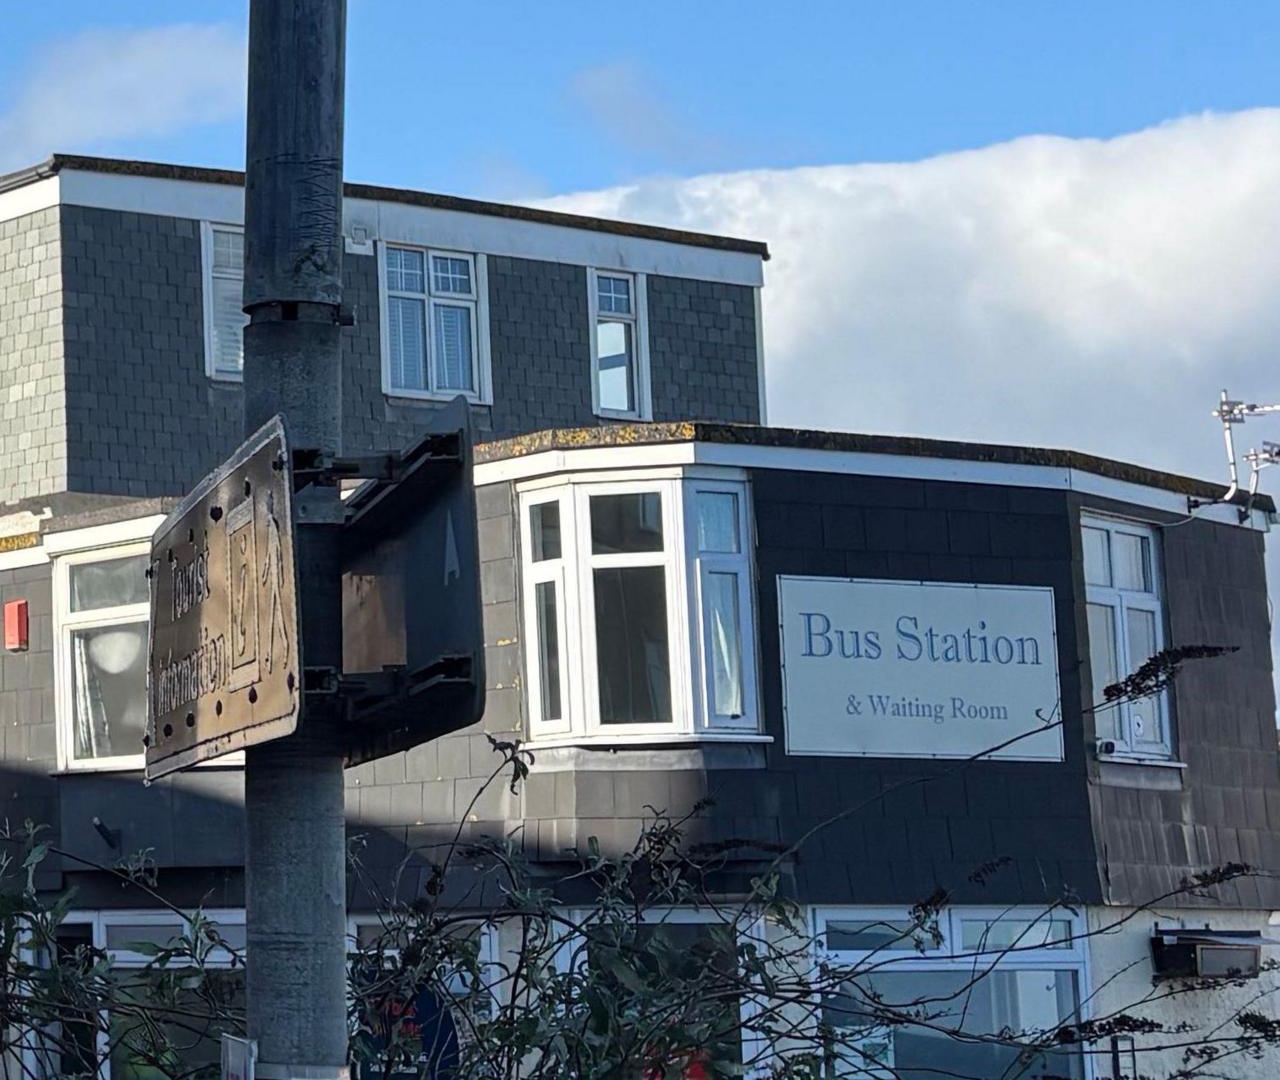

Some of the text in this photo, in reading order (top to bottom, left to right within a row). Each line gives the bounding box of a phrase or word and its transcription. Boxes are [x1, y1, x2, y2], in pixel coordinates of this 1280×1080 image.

[169, 531, 210, 622] Tourist
[798, 612, 1042, 665] Bus Station
[846, 694, 1008, 723] & Waiting Room
